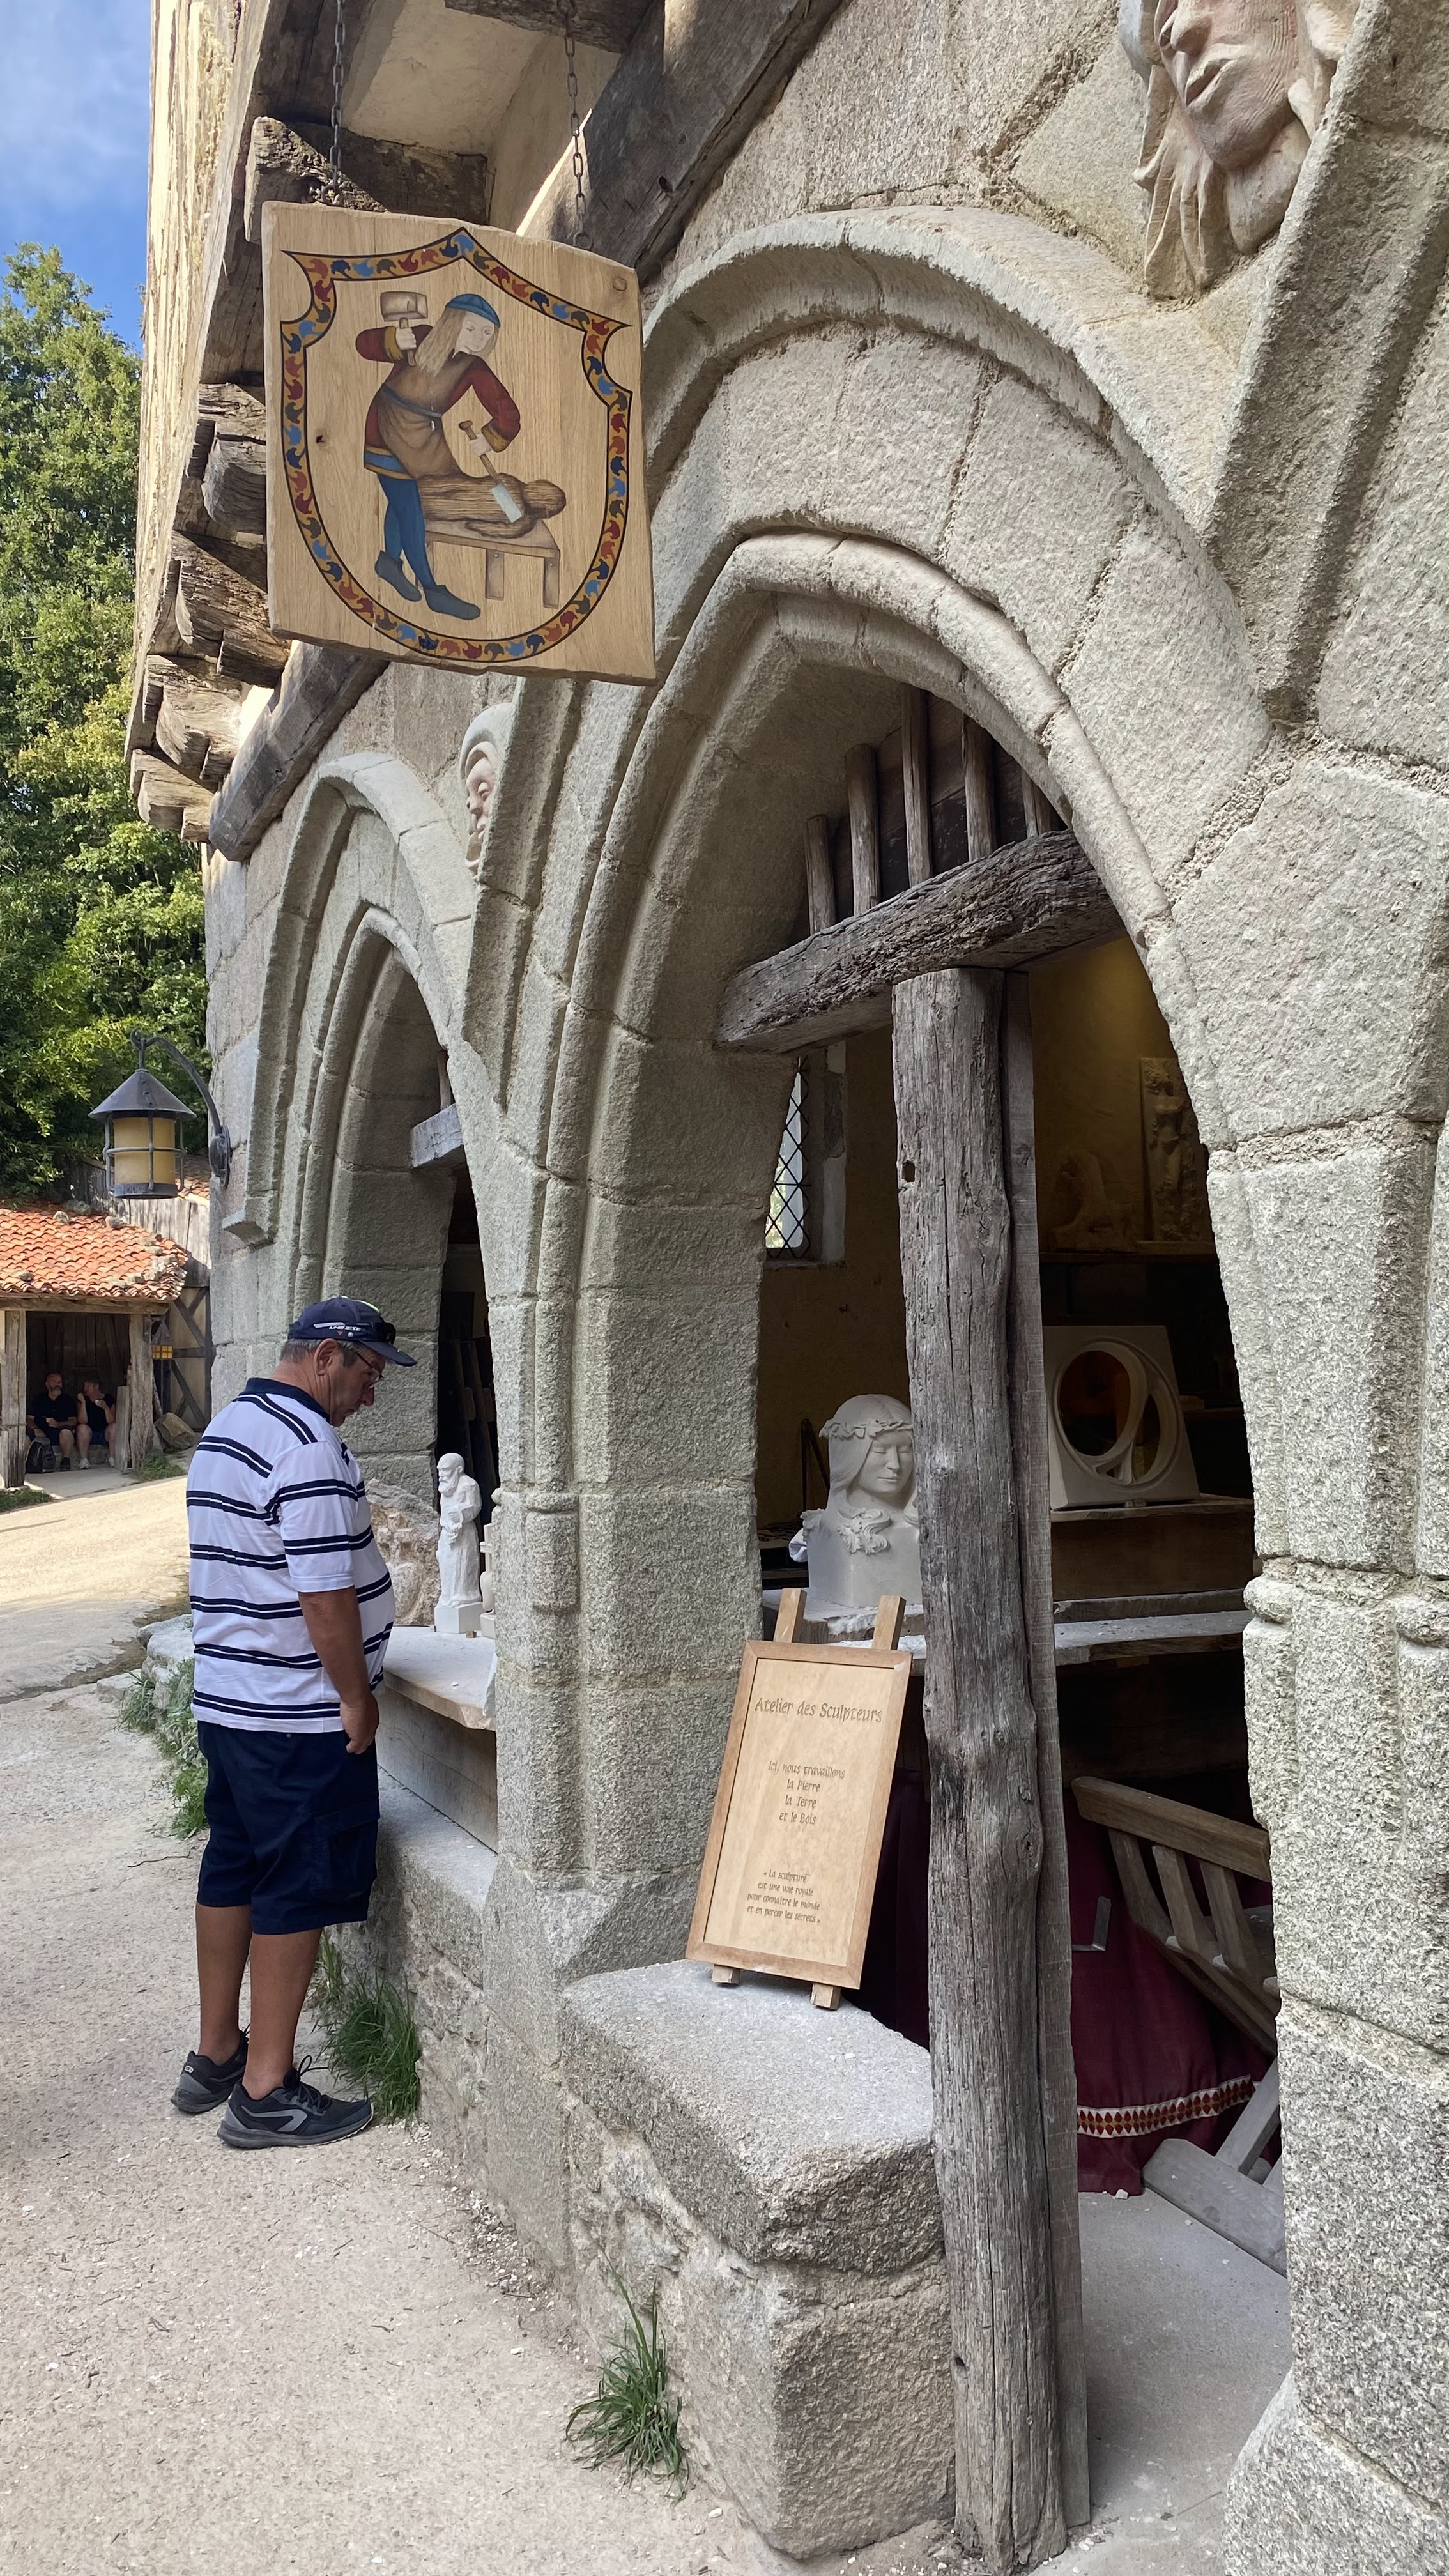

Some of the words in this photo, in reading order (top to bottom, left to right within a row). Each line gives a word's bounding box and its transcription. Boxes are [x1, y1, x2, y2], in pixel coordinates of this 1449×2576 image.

[755, 1697, 793, 1714] Atelier
[797, 1700, 816, 1717] des
[819, 1703, 883, 1723] Sculpteurs
[783, 1763, 801, 1774] nous
[804, 1765, 846, 1779] travaillons
[786, 1778, 794, 1789] la
[797, 1779, 821, 1792] Pierre
[785, 1794, 792, 1805] la
[796, 1795, 817, 1809] Terre
[779, 1812, 789, 1821] et
[790, 1811, 797, 1823] le
[799, 1813, 817, 1825] Bois
[778, 1871, 807, 1882] sculpture
[757, 1882, 767, 1890] est
[769, 1883, 781, 1892] une
[782, 1885, 794, 1894] voie
[795, 1887, 814, 1897] royale
[747, 1892, 762, 1901] pour
[793, 1897, 799, 1908] le
[800, 1901, 821, 1911] monde
[747, 1905, 755, 1913] et
[764, 1908, 783, 1917] percer
[785, 1910, 793, 1919] les
[794, 1913, 816, 1923] secrets
